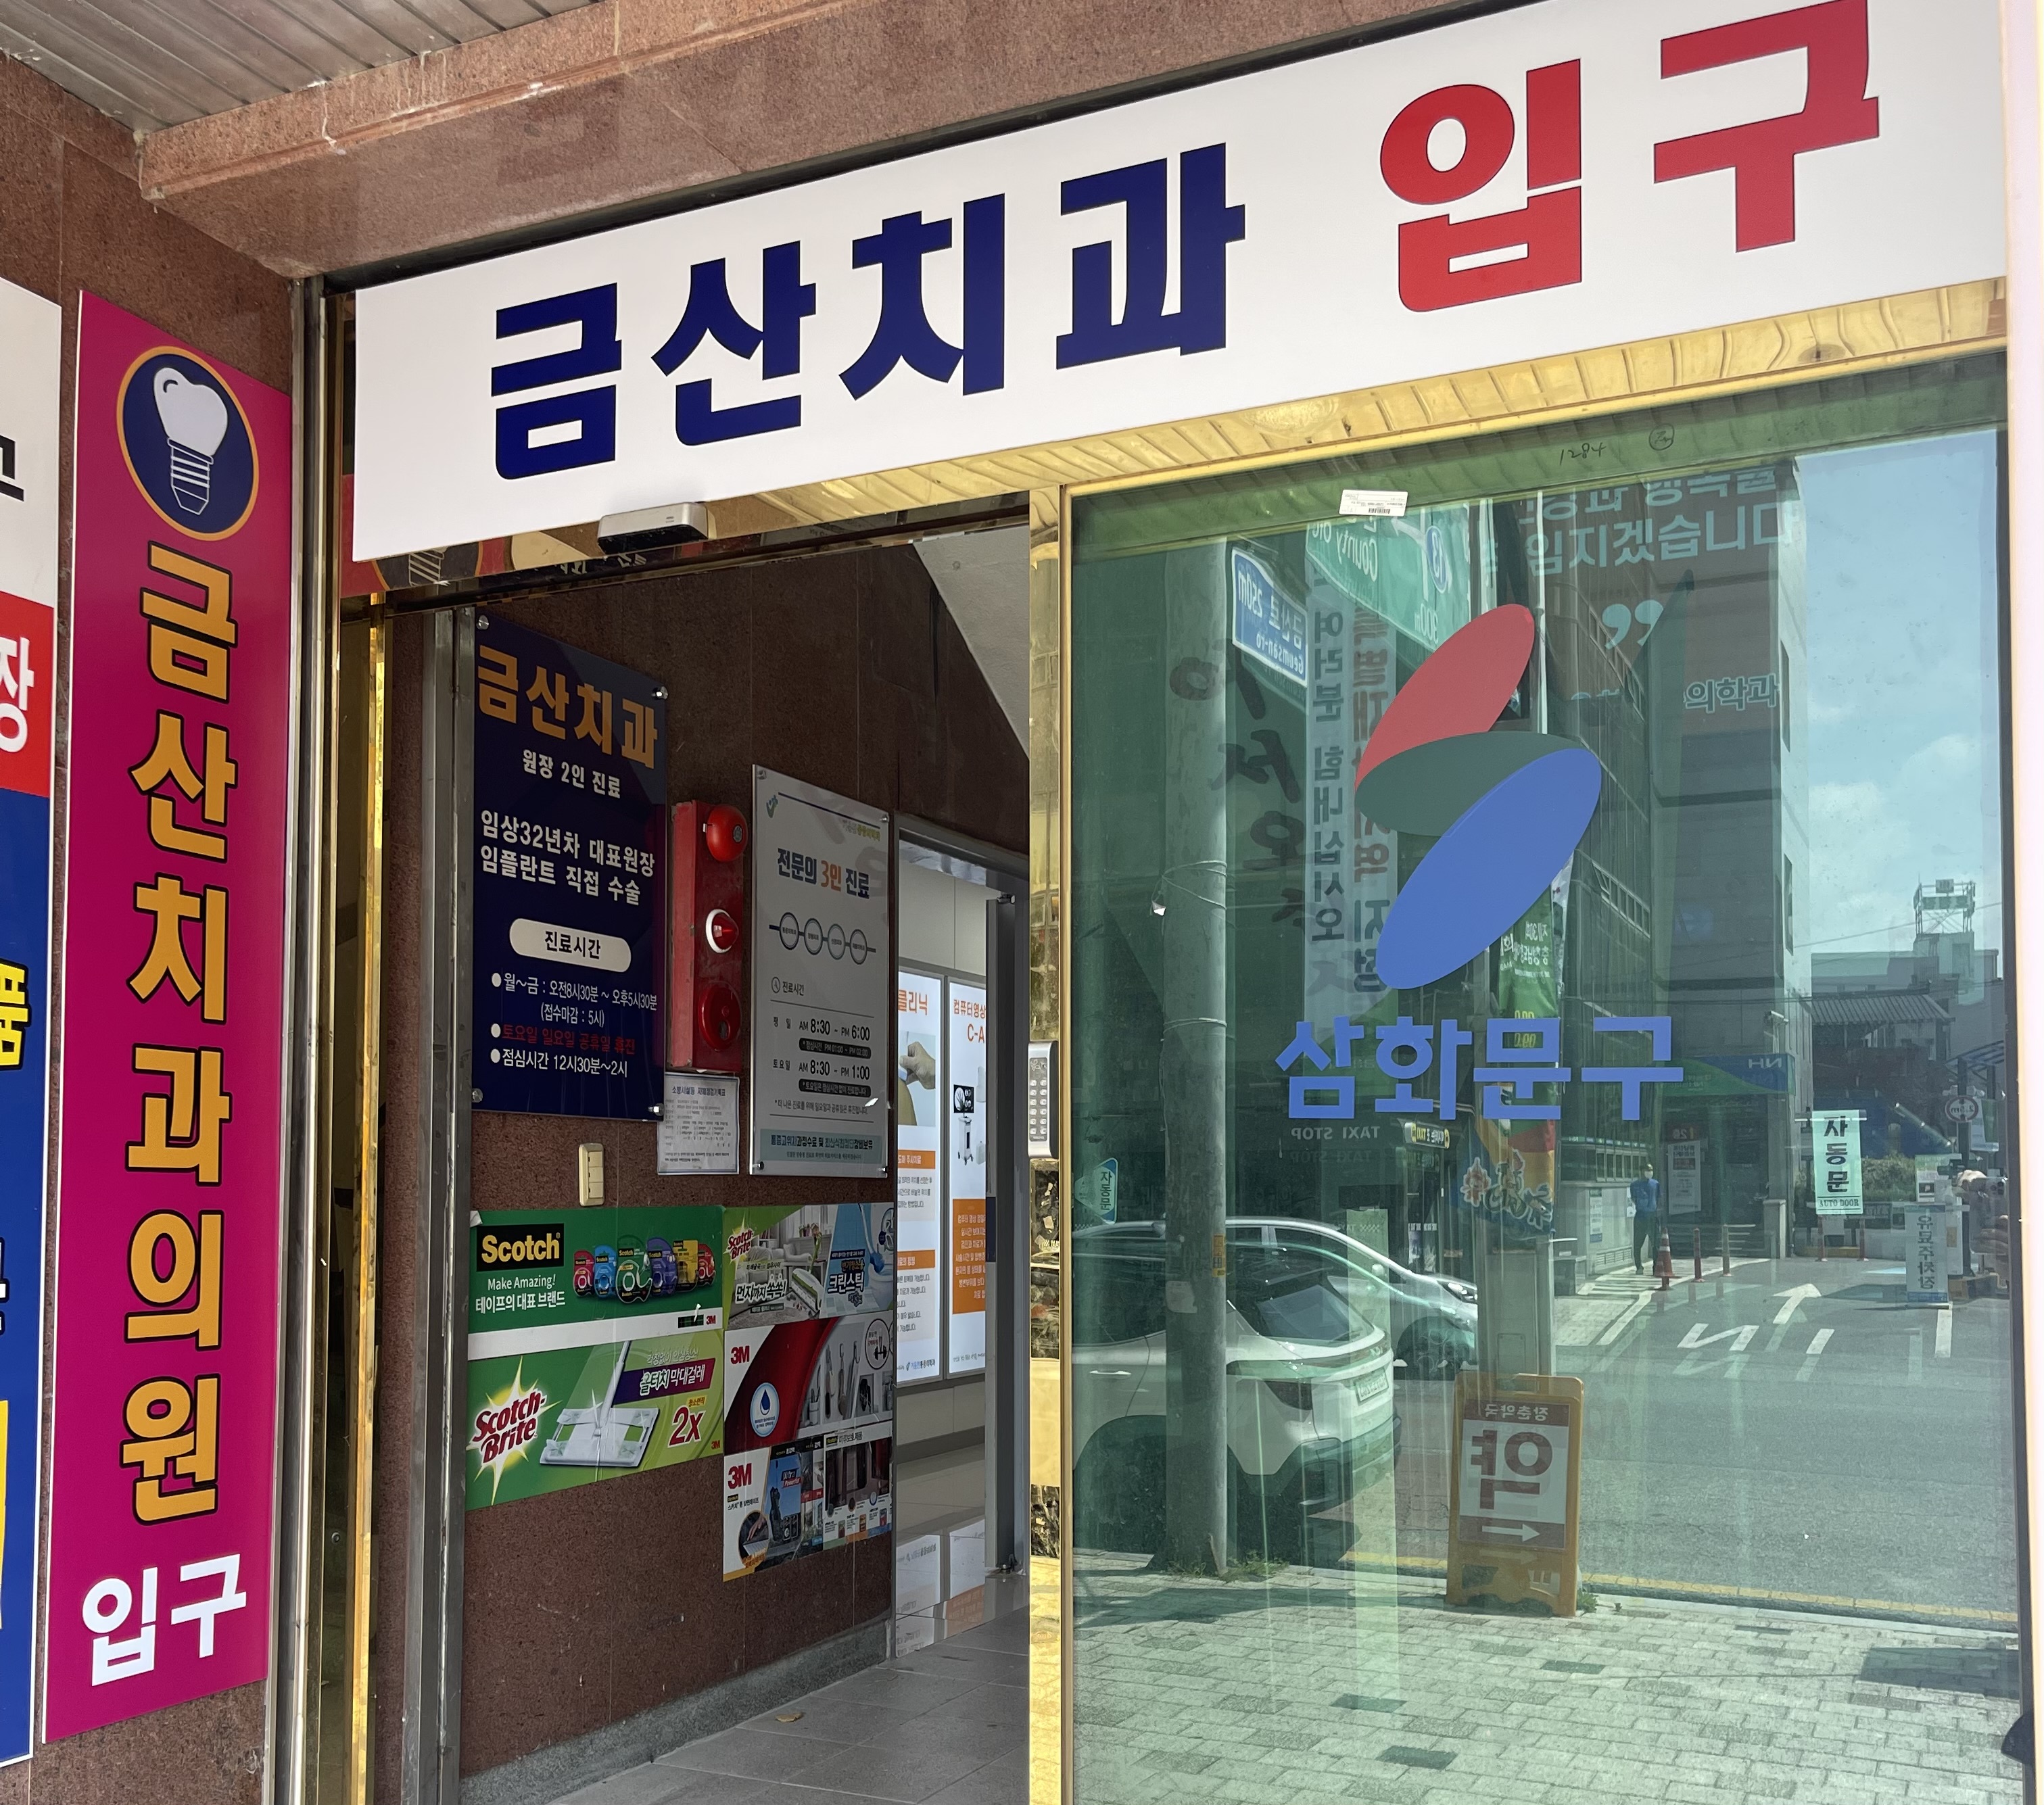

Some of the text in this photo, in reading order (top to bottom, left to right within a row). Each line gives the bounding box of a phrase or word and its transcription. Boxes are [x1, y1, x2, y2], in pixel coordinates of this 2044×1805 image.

[491, 0, 1880, 479] 금산치과 입구
[478, 644, 658, 769] 금산치과
[523, 749, 621, 799] 원장 2인 진료
[481, 810, 655, 877] 임상32년차 대표원장
[481, 845, 641, 906] 임플란트 직접 수술
[778, 848, 870, 899] 전문의 3인 진료
[544, 930, 601, 960] 진료시간
[782, 981, 805, 996] 진료시간
[898, 990, 928, 1015] 클리닉
[120, 540, 239, 1526] 금산치과의원
[502, 1024, 538, 1044] 토요일
[542, 1028, 575, 1048] 일요일
[579, 1033, 611, 1052] 공휴일
[799, 1021, 809, 1031] AM
[810, 1018, 830, 1036] 8:30
[840, 1027, 850, 1037] PM
[851, 1025, 870, 1041] 6:00
[502, 1049, 549, 1070] 점심시간
[773, 1059, 870, 1080] 토요일 AM 8:30 PM 1:00
[1275, 1016, 1684, 1120] 삼화문구
[1823, 1115, 1849, 1193] 자동문
[1819, 1197, 1859, 1208] AUTO DOOR
[481, 1232, 560, 1264] Scotch
[731, 1241, 751, 1260] Brite
[488, 1274, 556, 1291] Make Amazing!
[828, 1272, 864, 1293] 크린스틱
[476, 1291, 566, 1314] 테이프의 대표 브랜드
[706, 1314, 716, 1326] 3M
[730, 1345, 750, 1365] 3M
[481, 1417, 538, 1464] Brite
[711, 1440, 721, 1450] 3M
[728, 1462, 752, 1490] 3M
[82, 1552, 247, 1687] 입구
